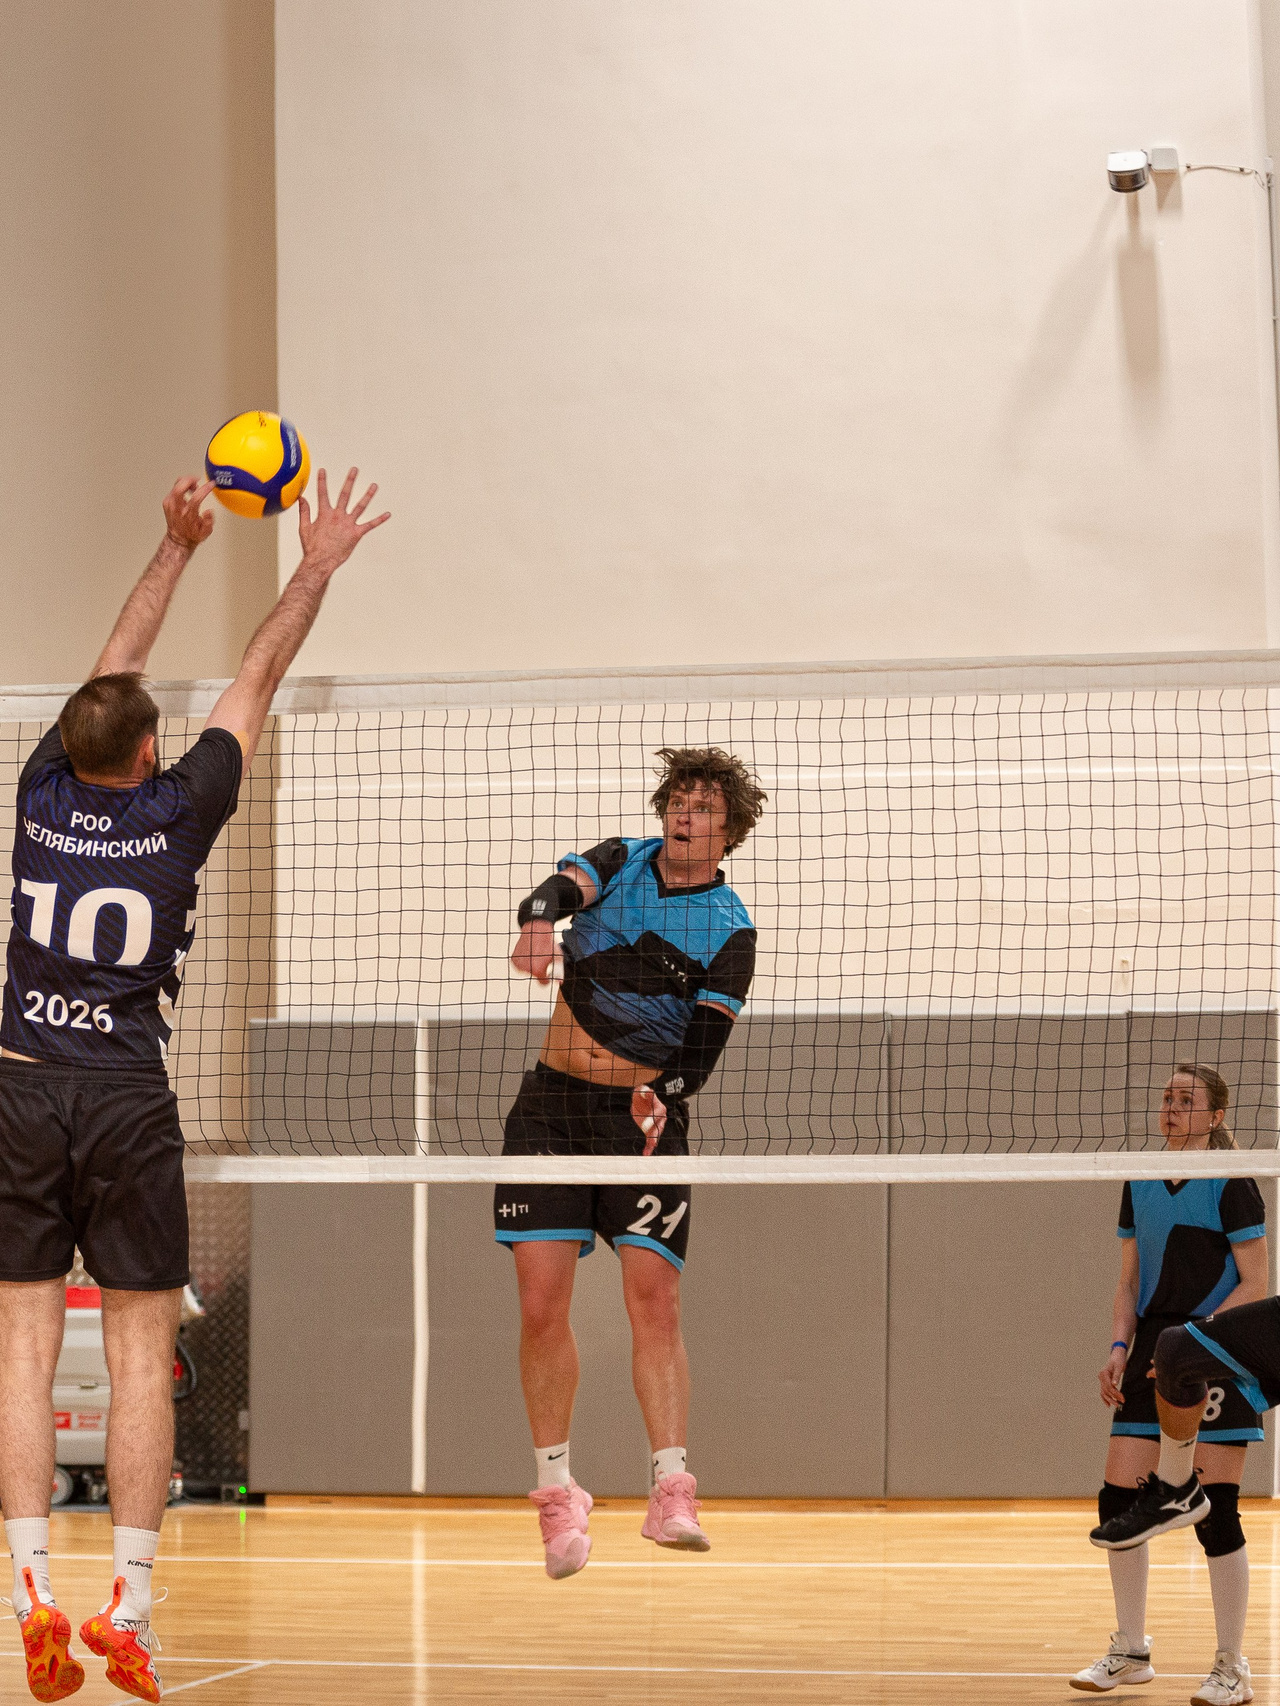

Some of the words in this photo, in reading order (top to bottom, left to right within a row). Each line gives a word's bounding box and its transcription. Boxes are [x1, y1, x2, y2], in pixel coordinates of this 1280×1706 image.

[23, 816, 168, 858] ЧЕЛЯБИНСКИЙ
[70, 810, 112, 832] РОО
[20, 878, 153, 966] 10
[23, 990, 114, 1033] 2026
[626, 1194, 688, 1240] 21
